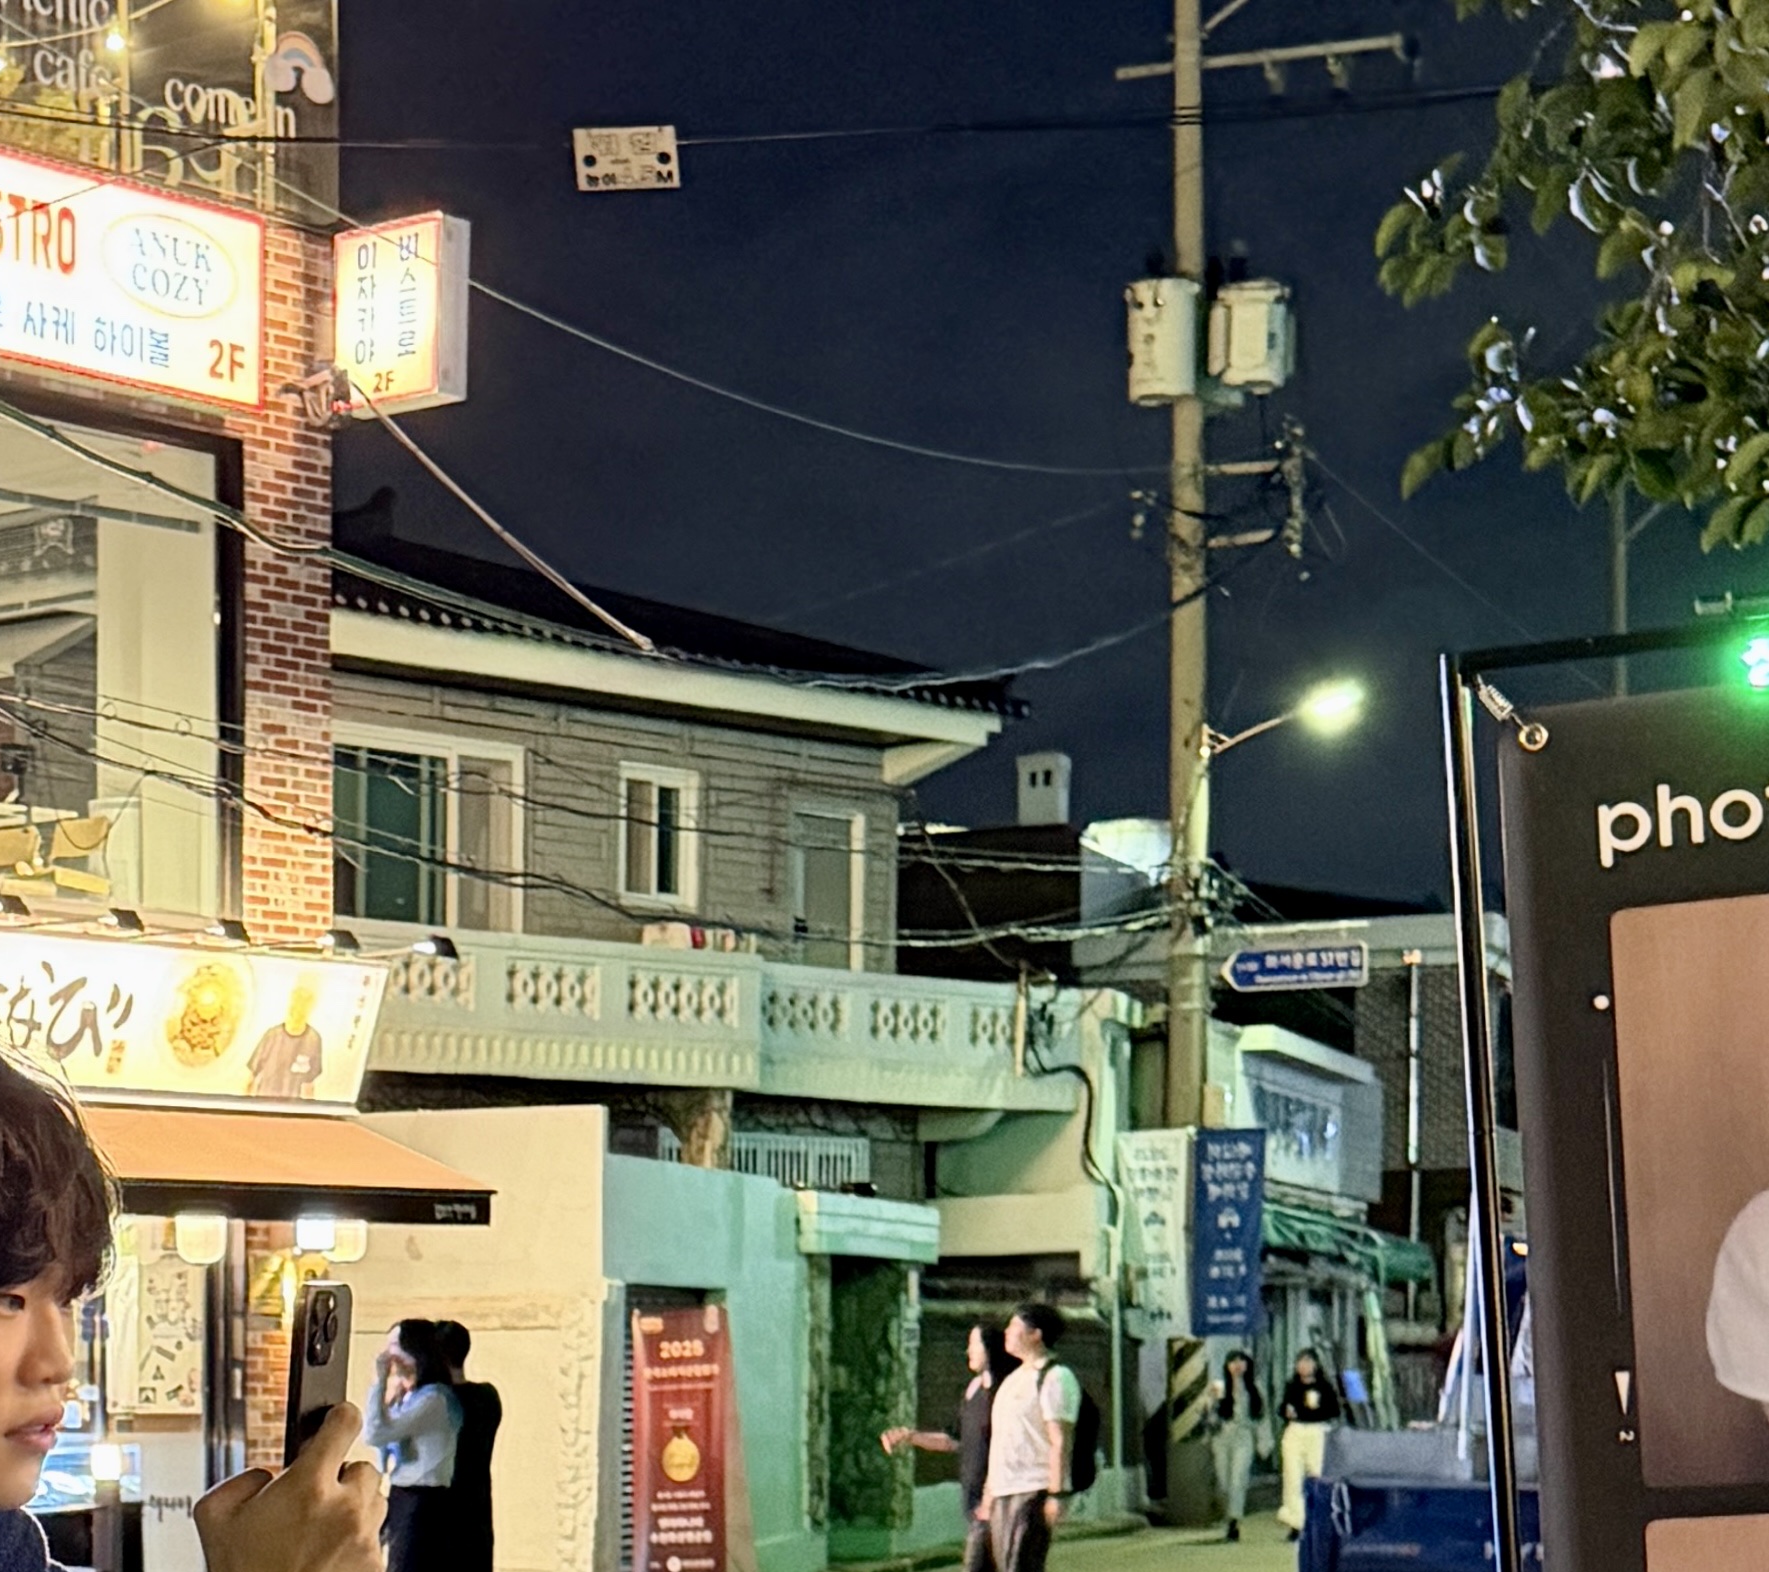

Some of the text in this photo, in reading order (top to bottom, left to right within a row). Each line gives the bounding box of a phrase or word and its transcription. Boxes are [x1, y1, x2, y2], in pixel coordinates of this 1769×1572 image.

[33, 46, 112, 91] cafe
[164, 77, 257, 127] come
[130, 262, 211, 307] COZY
[355, 241, 377, 365] 이자카야
[397, 232, 420, 358] 비스트로
[23, 301, 76, 347] 사케
[93, 315, 170, 369] 하이볼
[208, 337, 246, 383] 2F
[372, 370, 395, 393] 2F
[1598, 783, 1769, 869] pho
[659, 1339, 705, 1359] 2025
